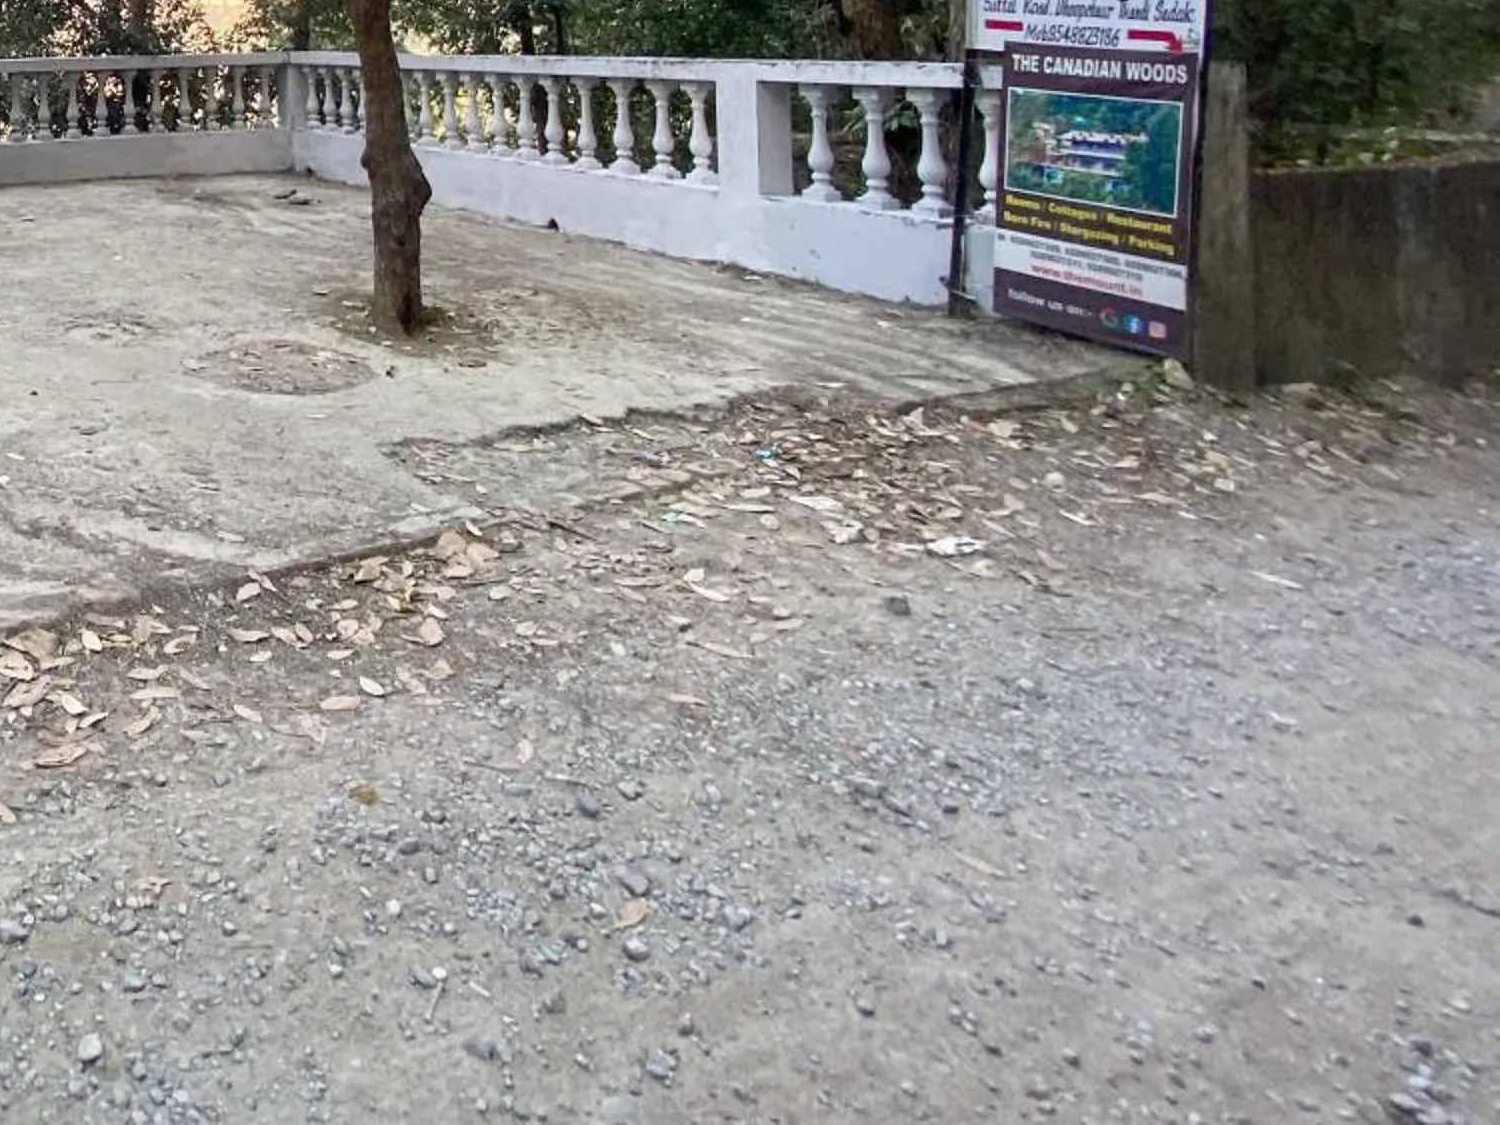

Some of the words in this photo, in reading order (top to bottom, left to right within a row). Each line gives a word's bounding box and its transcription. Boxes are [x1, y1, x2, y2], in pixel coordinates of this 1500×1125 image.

[1012, 54, 1039, 73] THE
[1043, 57, 1121, 80] CANADIAN
[1125, 63, 1188, 84] WOODS
